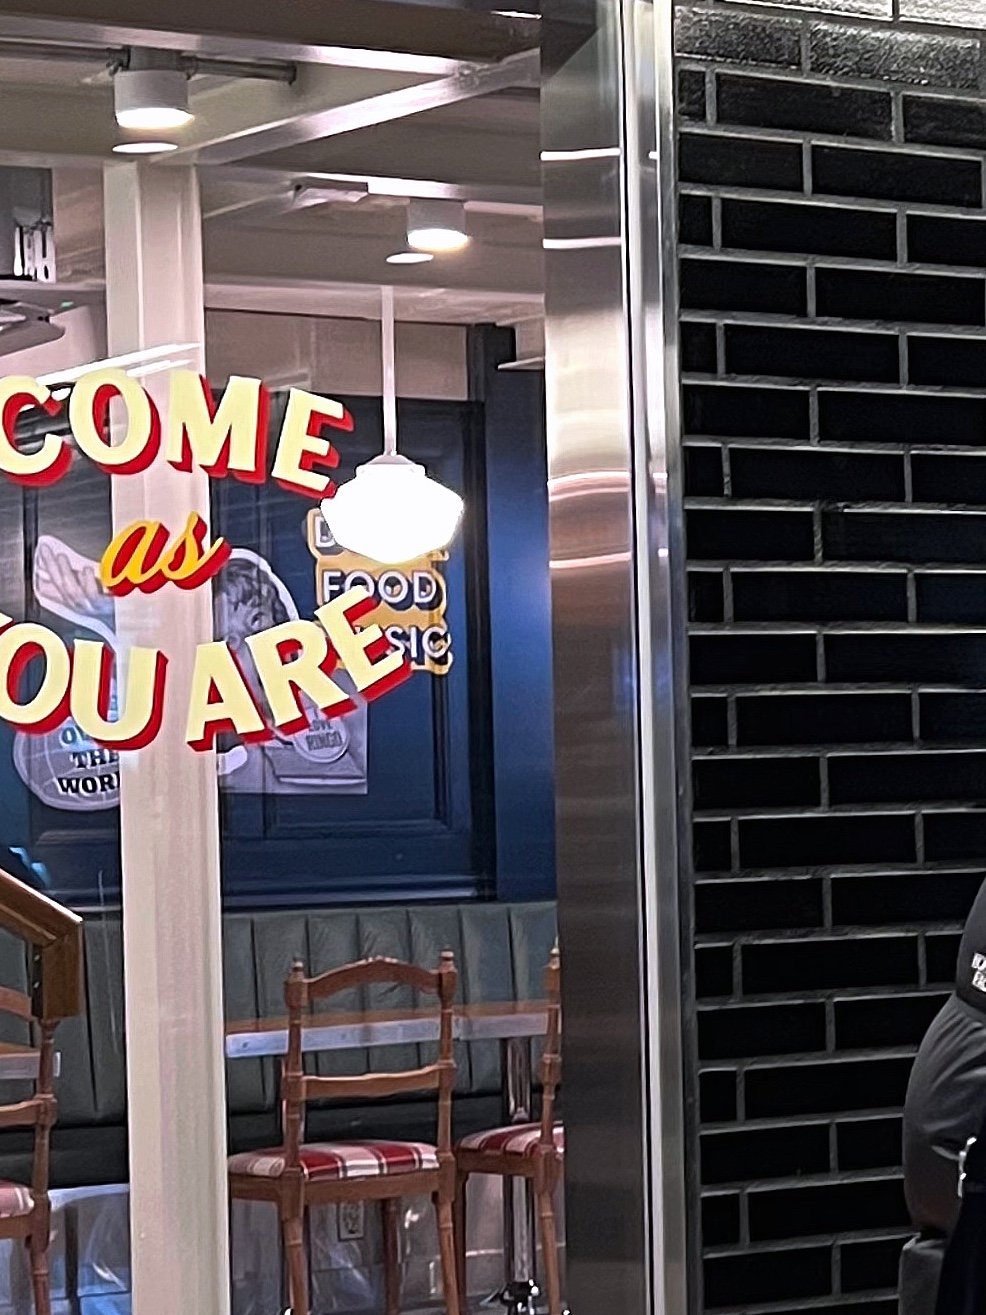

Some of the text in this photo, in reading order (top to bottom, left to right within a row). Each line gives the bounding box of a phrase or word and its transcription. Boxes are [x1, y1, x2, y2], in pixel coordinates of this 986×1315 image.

[0, 369, 354, 499] COME
[101, 511, 232, 597] as
[0, 585, 412, 752] OU ARE
